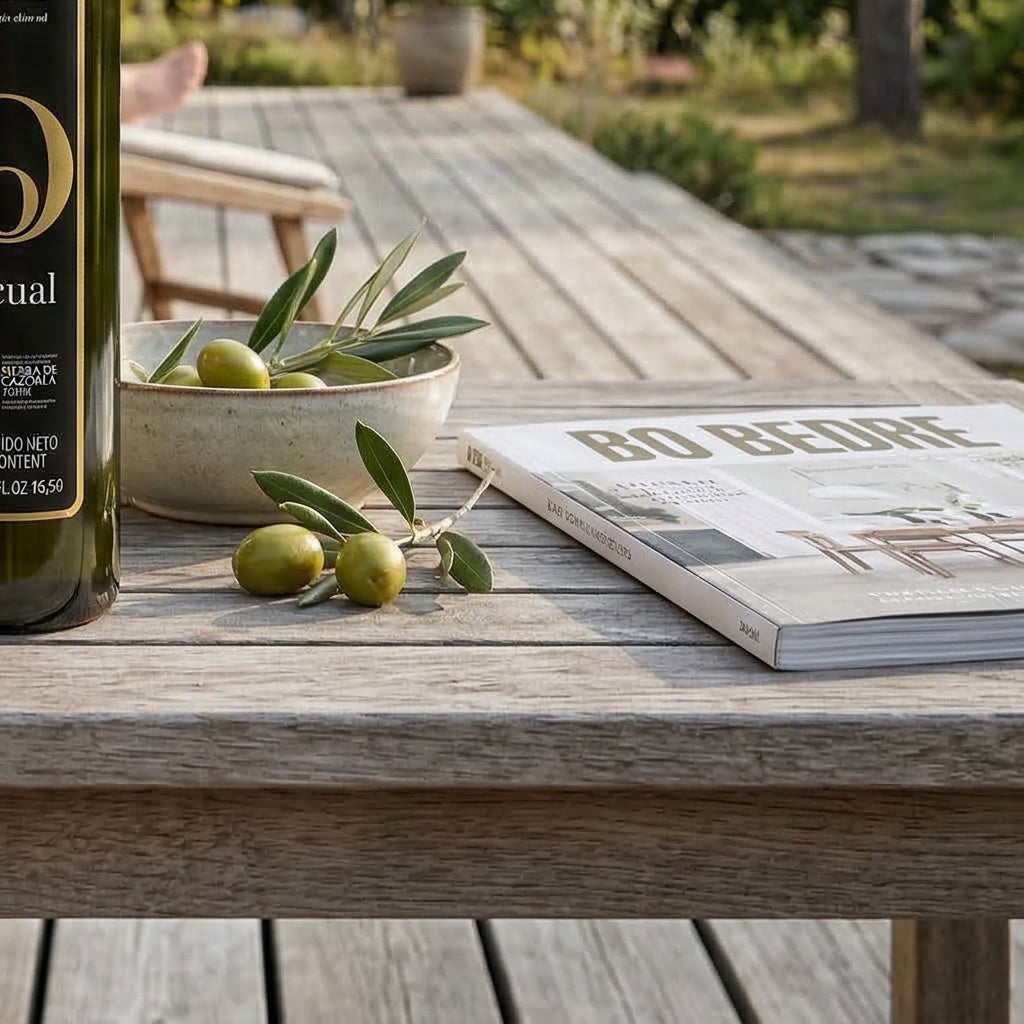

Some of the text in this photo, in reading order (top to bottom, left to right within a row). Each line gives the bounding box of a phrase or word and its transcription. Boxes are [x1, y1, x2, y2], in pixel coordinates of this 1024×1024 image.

[43, 364, 58, 375] DE
[26, 435, 59, 451] NETO
[566, 416, 1002, 463] BO BEDRE
